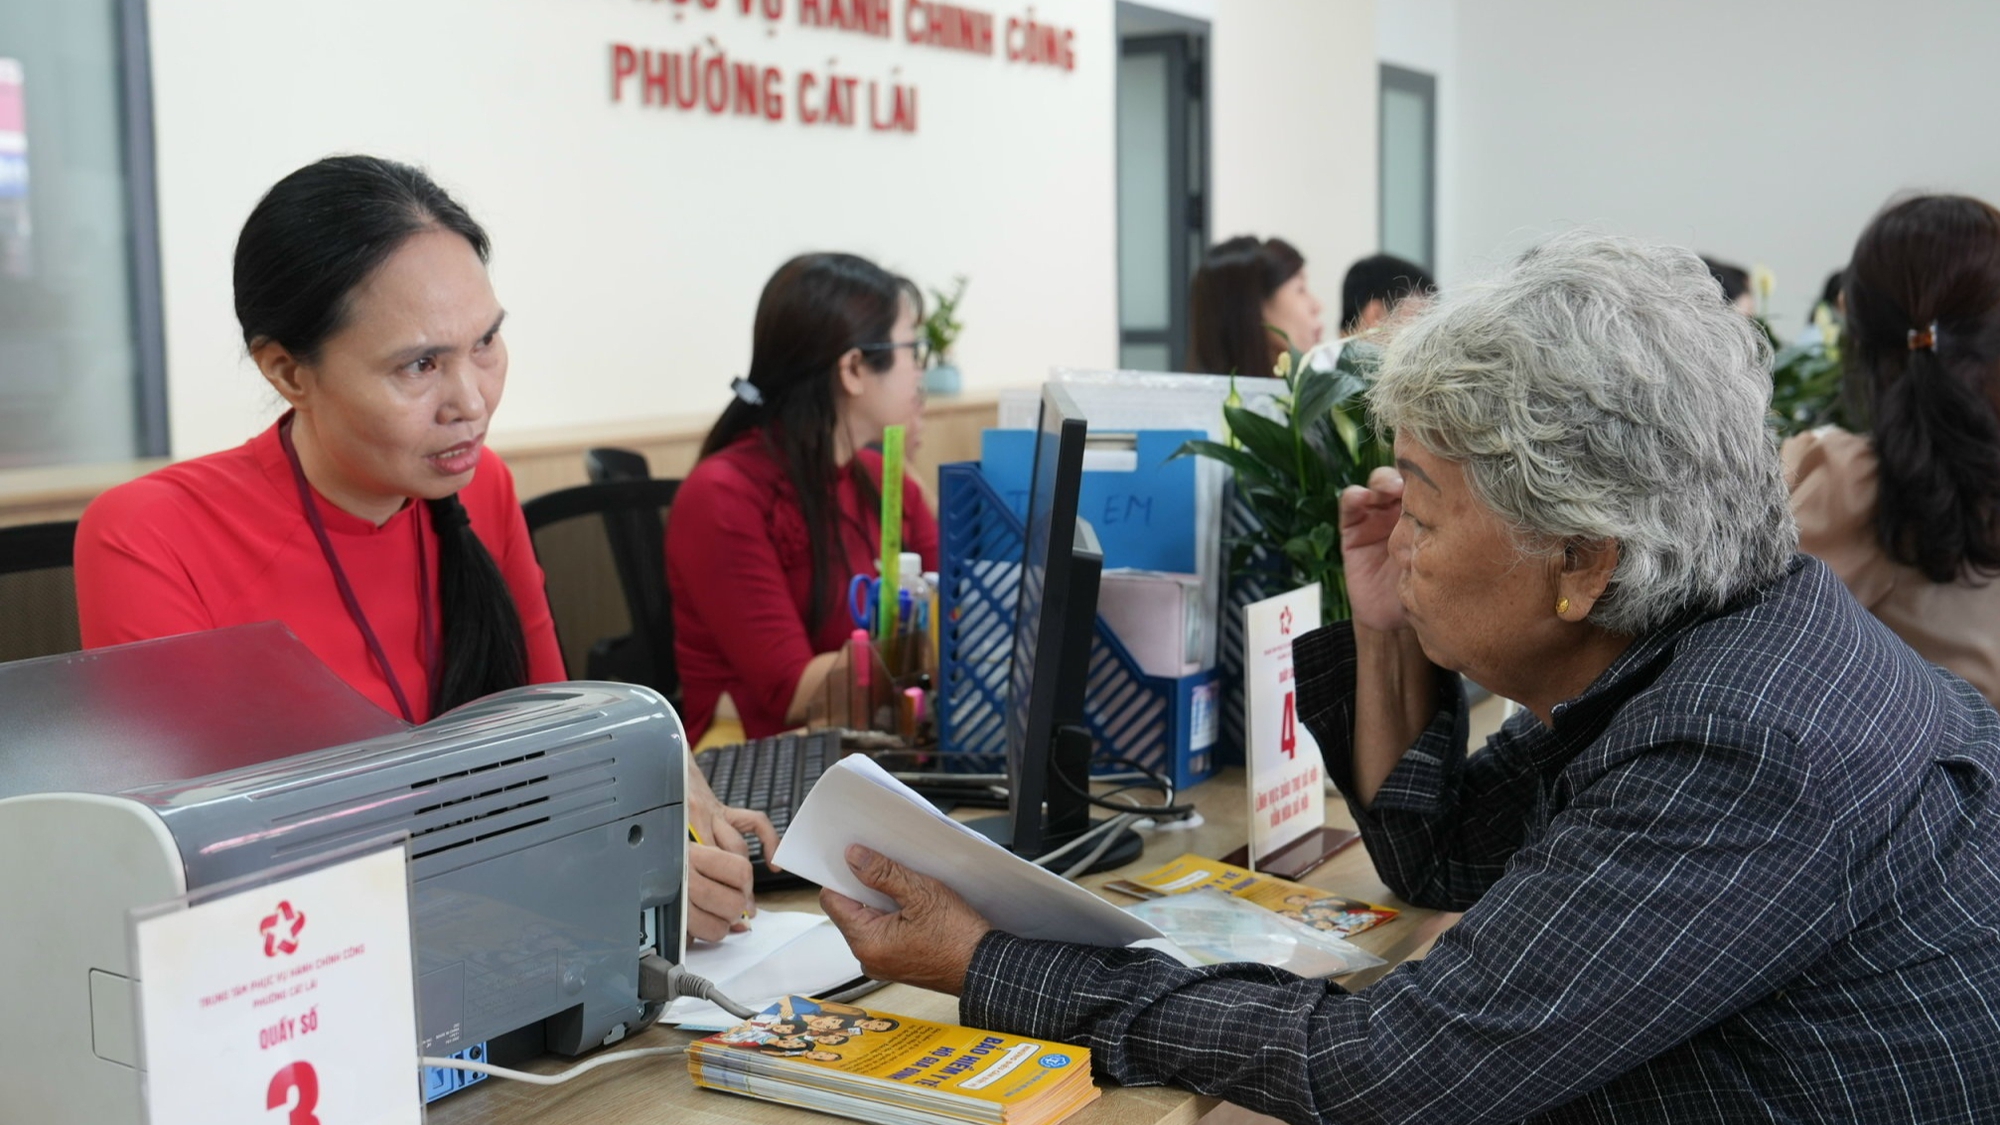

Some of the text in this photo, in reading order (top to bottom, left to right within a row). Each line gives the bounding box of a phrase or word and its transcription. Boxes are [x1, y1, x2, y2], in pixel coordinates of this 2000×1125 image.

[611, 35, 784, 122] PHƯỜNG
[797, 57, 860, 127] CÁT
[1104, 494, 1153, 525] EM
[1281, 691, 1296, 760] 4
[300, 1002, 319, 1034] SỐ
[914, 1036, 1005, 1088] BẢO HIỂM Y TẾ
[929, 1046, 956, 1057] HỘ
[266, 1060, 322, 1125] 3
